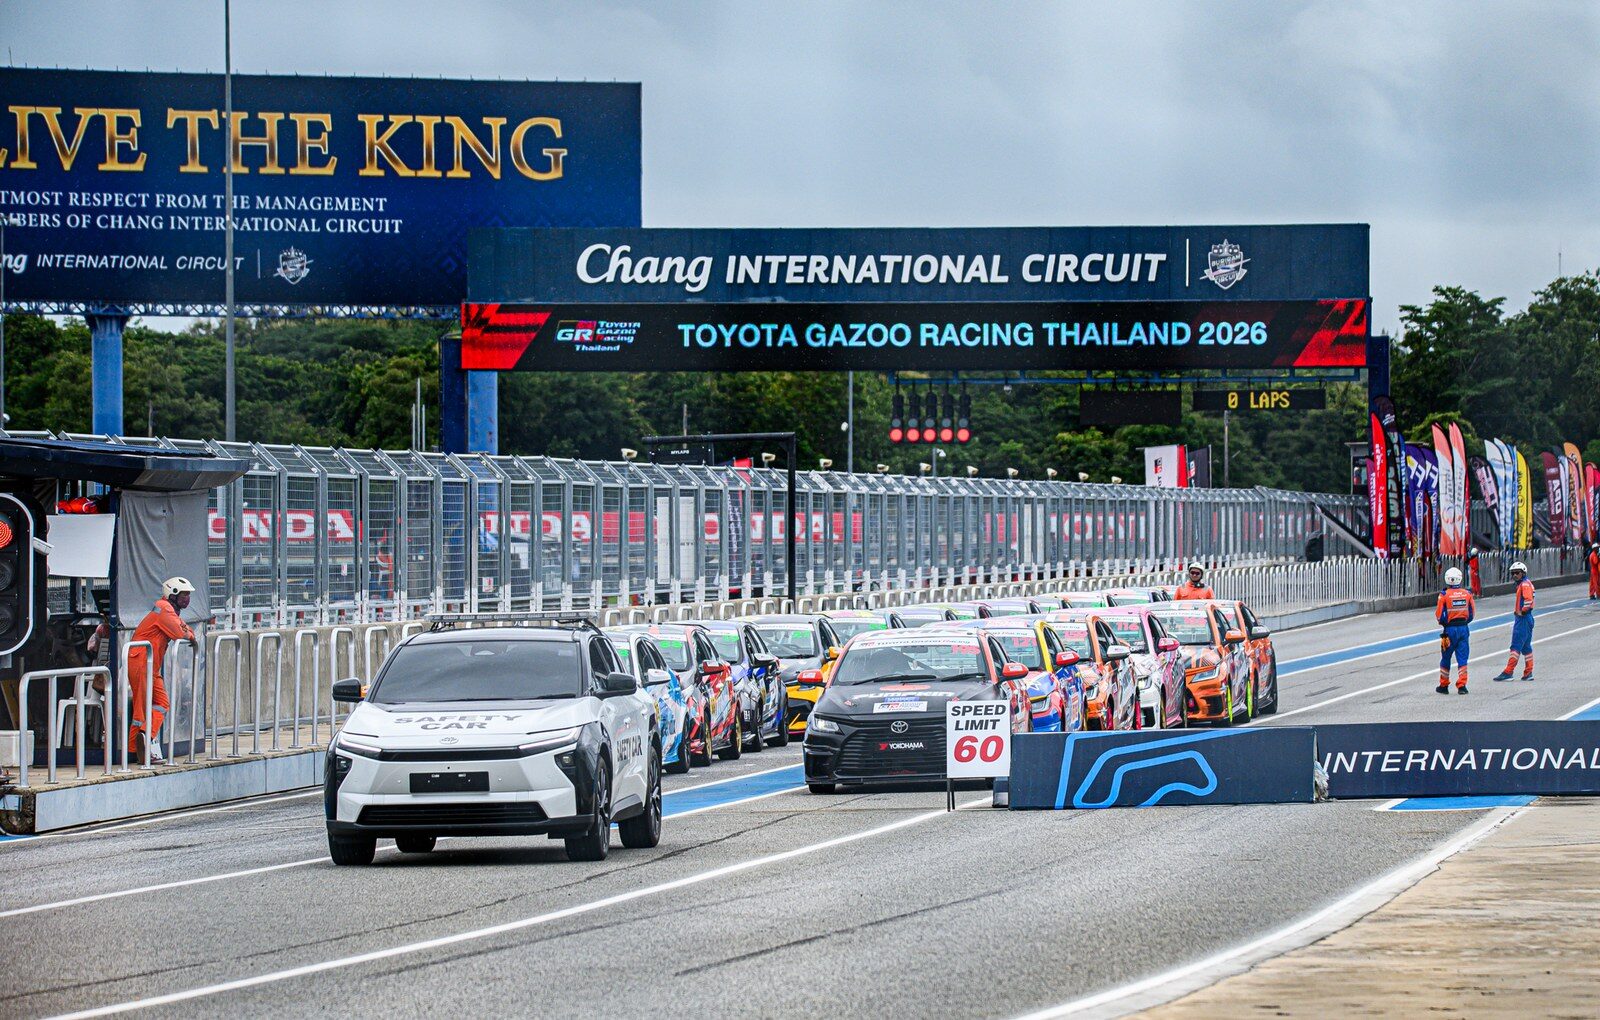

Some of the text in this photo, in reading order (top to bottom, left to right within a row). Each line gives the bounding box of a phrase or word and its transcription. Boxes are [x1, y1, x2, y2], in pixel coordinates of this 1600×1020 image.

[0, 105, 568, 181] IVE THE KING
[68, 192, 150, 207] RESPECT
[155, 194, 207, 209] FROM
[255, 196, 388, 212] MANAGEMENT
[66, 214, 92, 228] OF
[96, 215, 164, 230] CHANG
[170, 216, 321, 232] INTERNATIONAL
[325, 218, 403, 233] CIRCUIT
[36, 254, 168, 270] INTERNATIONAL
[176, 256, 244, 270] CIRCUT
[576, 243, 1167, 293] Chang INTERNATIONAL CIRCUIT
[557, 329, 588, 341] GR
[678, 321, 1268, 348] TOYOTA GAZOO RACING THAILAND 2026
[1228, 391, 1291, 409] 0 LAPS
[394, 715, 522, 724] SAFETY
[951, 704, 1007, 717] SPEED
[421, 722, 487, 731] CAR
[954, 718, 1001, 731] LIMIT
[889, 742, 924, 750] YOKOHAMA
[953, 735, 1004, 763] 60
[1323, 747, 1600, 774] INTERNATIONAL
